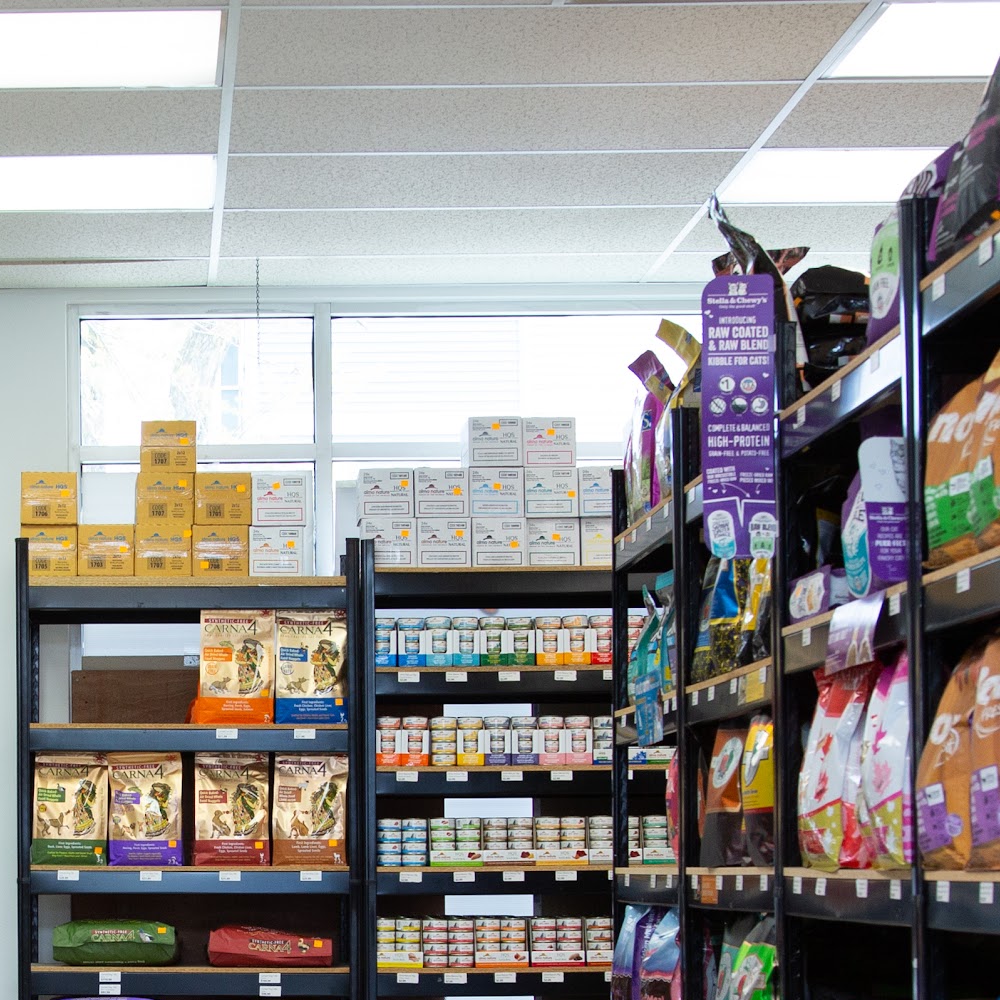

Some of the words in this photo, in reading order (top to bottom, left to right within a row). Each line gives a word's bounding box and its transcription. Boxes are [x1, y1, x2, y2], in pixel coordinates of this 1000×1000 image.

[719, 316, 757, 324] INTRODUCING
[708, 327, 730, 338] RAW
[732, 326, 769, 338] COATED
[708, 340, 717, 351] &
[719, 340, 739, 350] RAW
[740, 339, 769, 350] BLEND
[708, 356, 733, 365] KIBBLE
[734, 356, 749, 365] FOR
[749, 355, 770, 364] CATS!
[708, 424, 737, 432] COMPLETE
[742, 423, 770, 431] BALANCED
[708, 435, 771, 447] HIGH-PROTEIN
[204, 621, 258, 636] CARNA4
[279, 624, 333, 636] CARNA4
[38, 766, 89, 777] CARNA4
[112, 765, 165, 780] CARNA4
[278, 762, 327, 777] CARNA4
[90, 930, 136, 942] CARNA4
[247, 940, 292, 954] CARNA4
